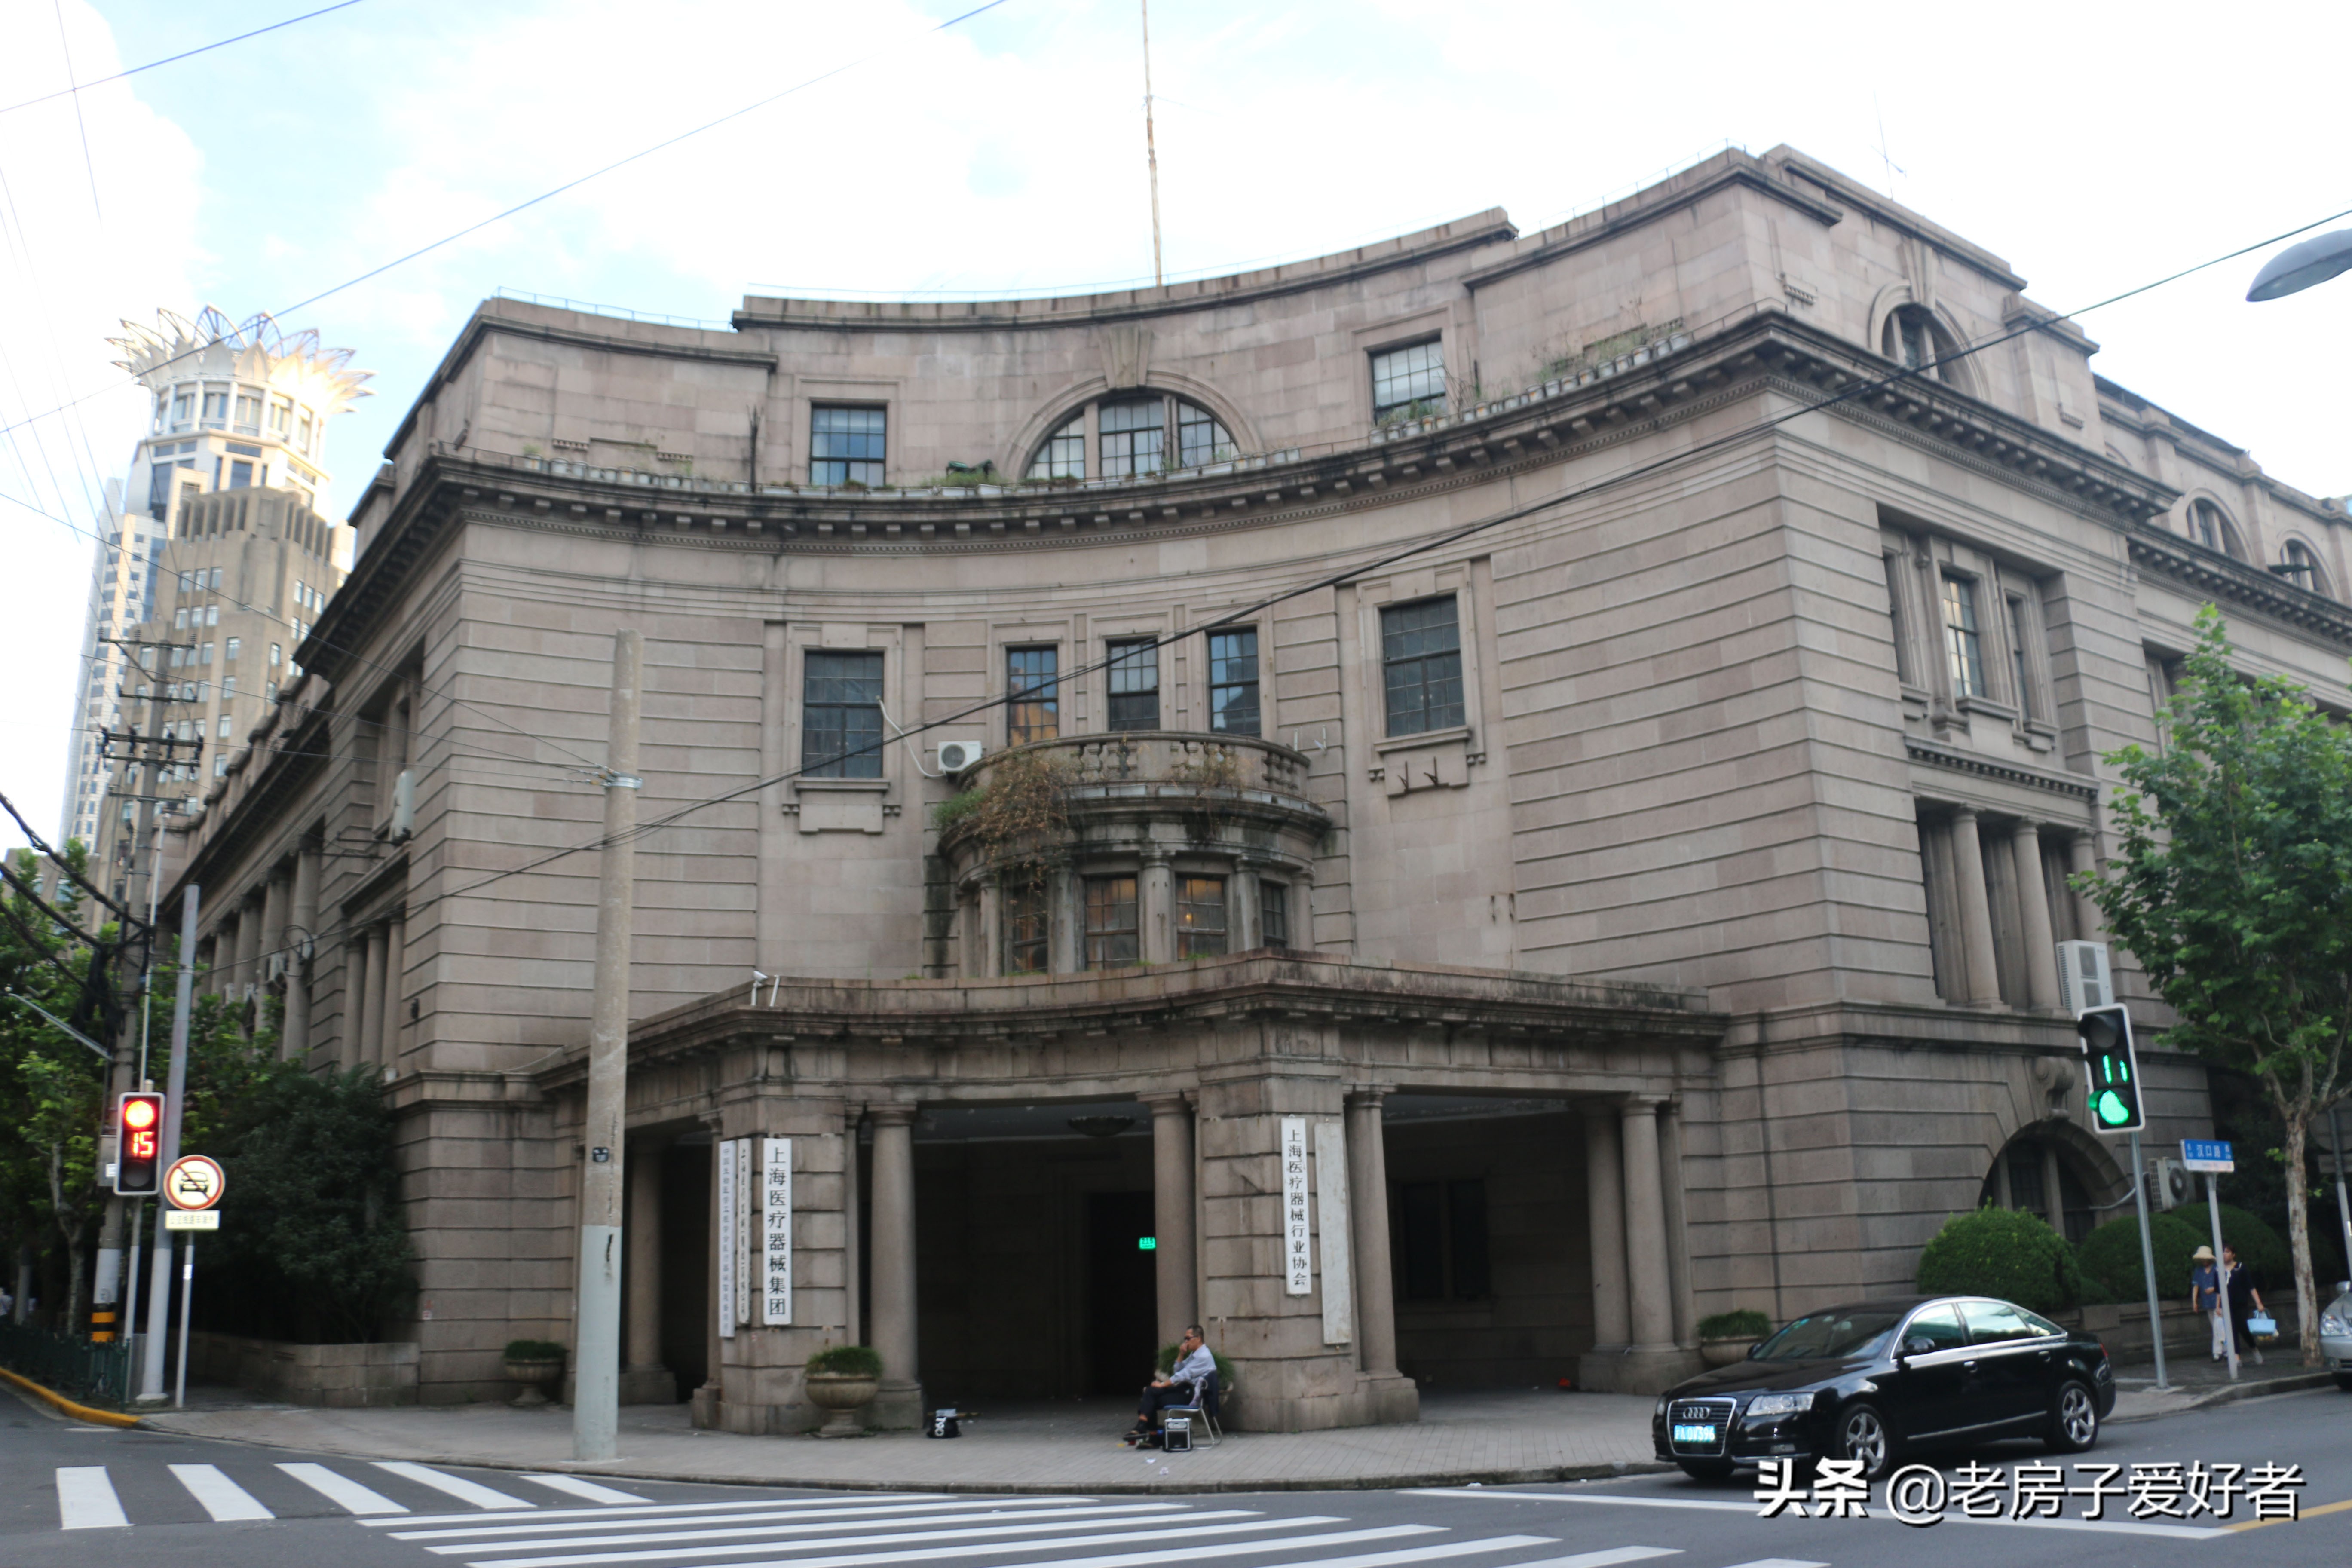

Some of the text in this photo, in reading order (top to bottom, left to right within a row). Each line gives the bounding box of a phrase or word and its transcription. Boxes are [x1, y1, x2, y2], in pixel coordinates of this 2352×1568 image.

[2103, 1055, 2128, 1083] 11
[133, 1131, 153, 1155] 15
[2197, 1144, 2221, 1158] 汉口路
[1288, 1129, 1307, 1286] 上海医疗器械行业协会
[768, 1147, 787, 1316] 上海医疗器械集团
